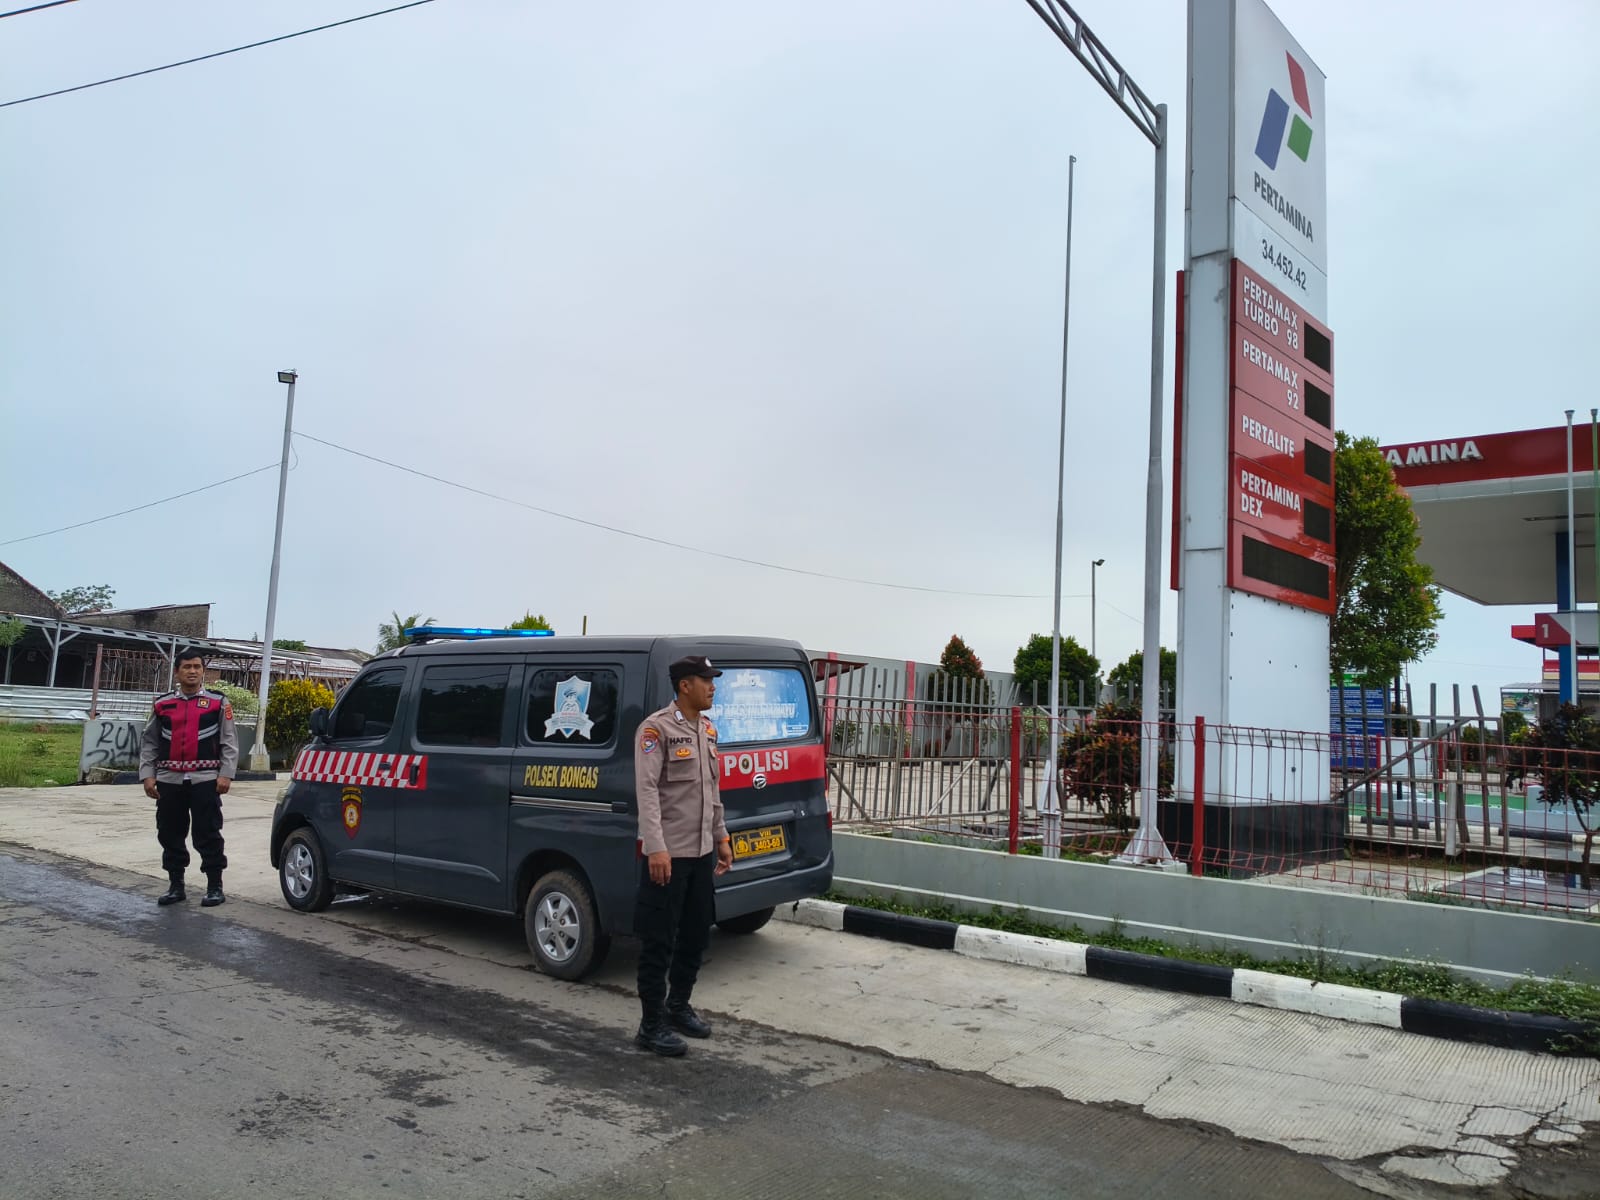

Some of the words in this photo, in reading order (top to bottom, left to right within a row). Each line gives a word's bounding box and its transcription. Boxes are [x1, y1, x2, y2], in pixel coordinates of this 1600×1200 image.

[1254, 171, 1314, 243] PERTAMINA
[1262, 239, 1307, 291] 34.452.42
[1243, 276, 1298, 330] PERTAMAX
[1243, 298, 1279, 336] TURBO
[1286, 328, 1298, 350] 98
[1243, 339, 1298, 389] PERTAMAX
[1287, 389, 1299, 410] 92
[1242, 415, 1295, 458] PERTALITE
[1380, 440, 1483, 467] AMINA
[1241, 470, 1301, 512] PERTAMINA
[1241, 493, 1263, 518] DEX
[1541, 623, 1550, 639] 1
[523, 765, 560, 787] POLSEK
[560, 766, 599, 789] BONGAS
[723, 750, 789, 777] POLISI
